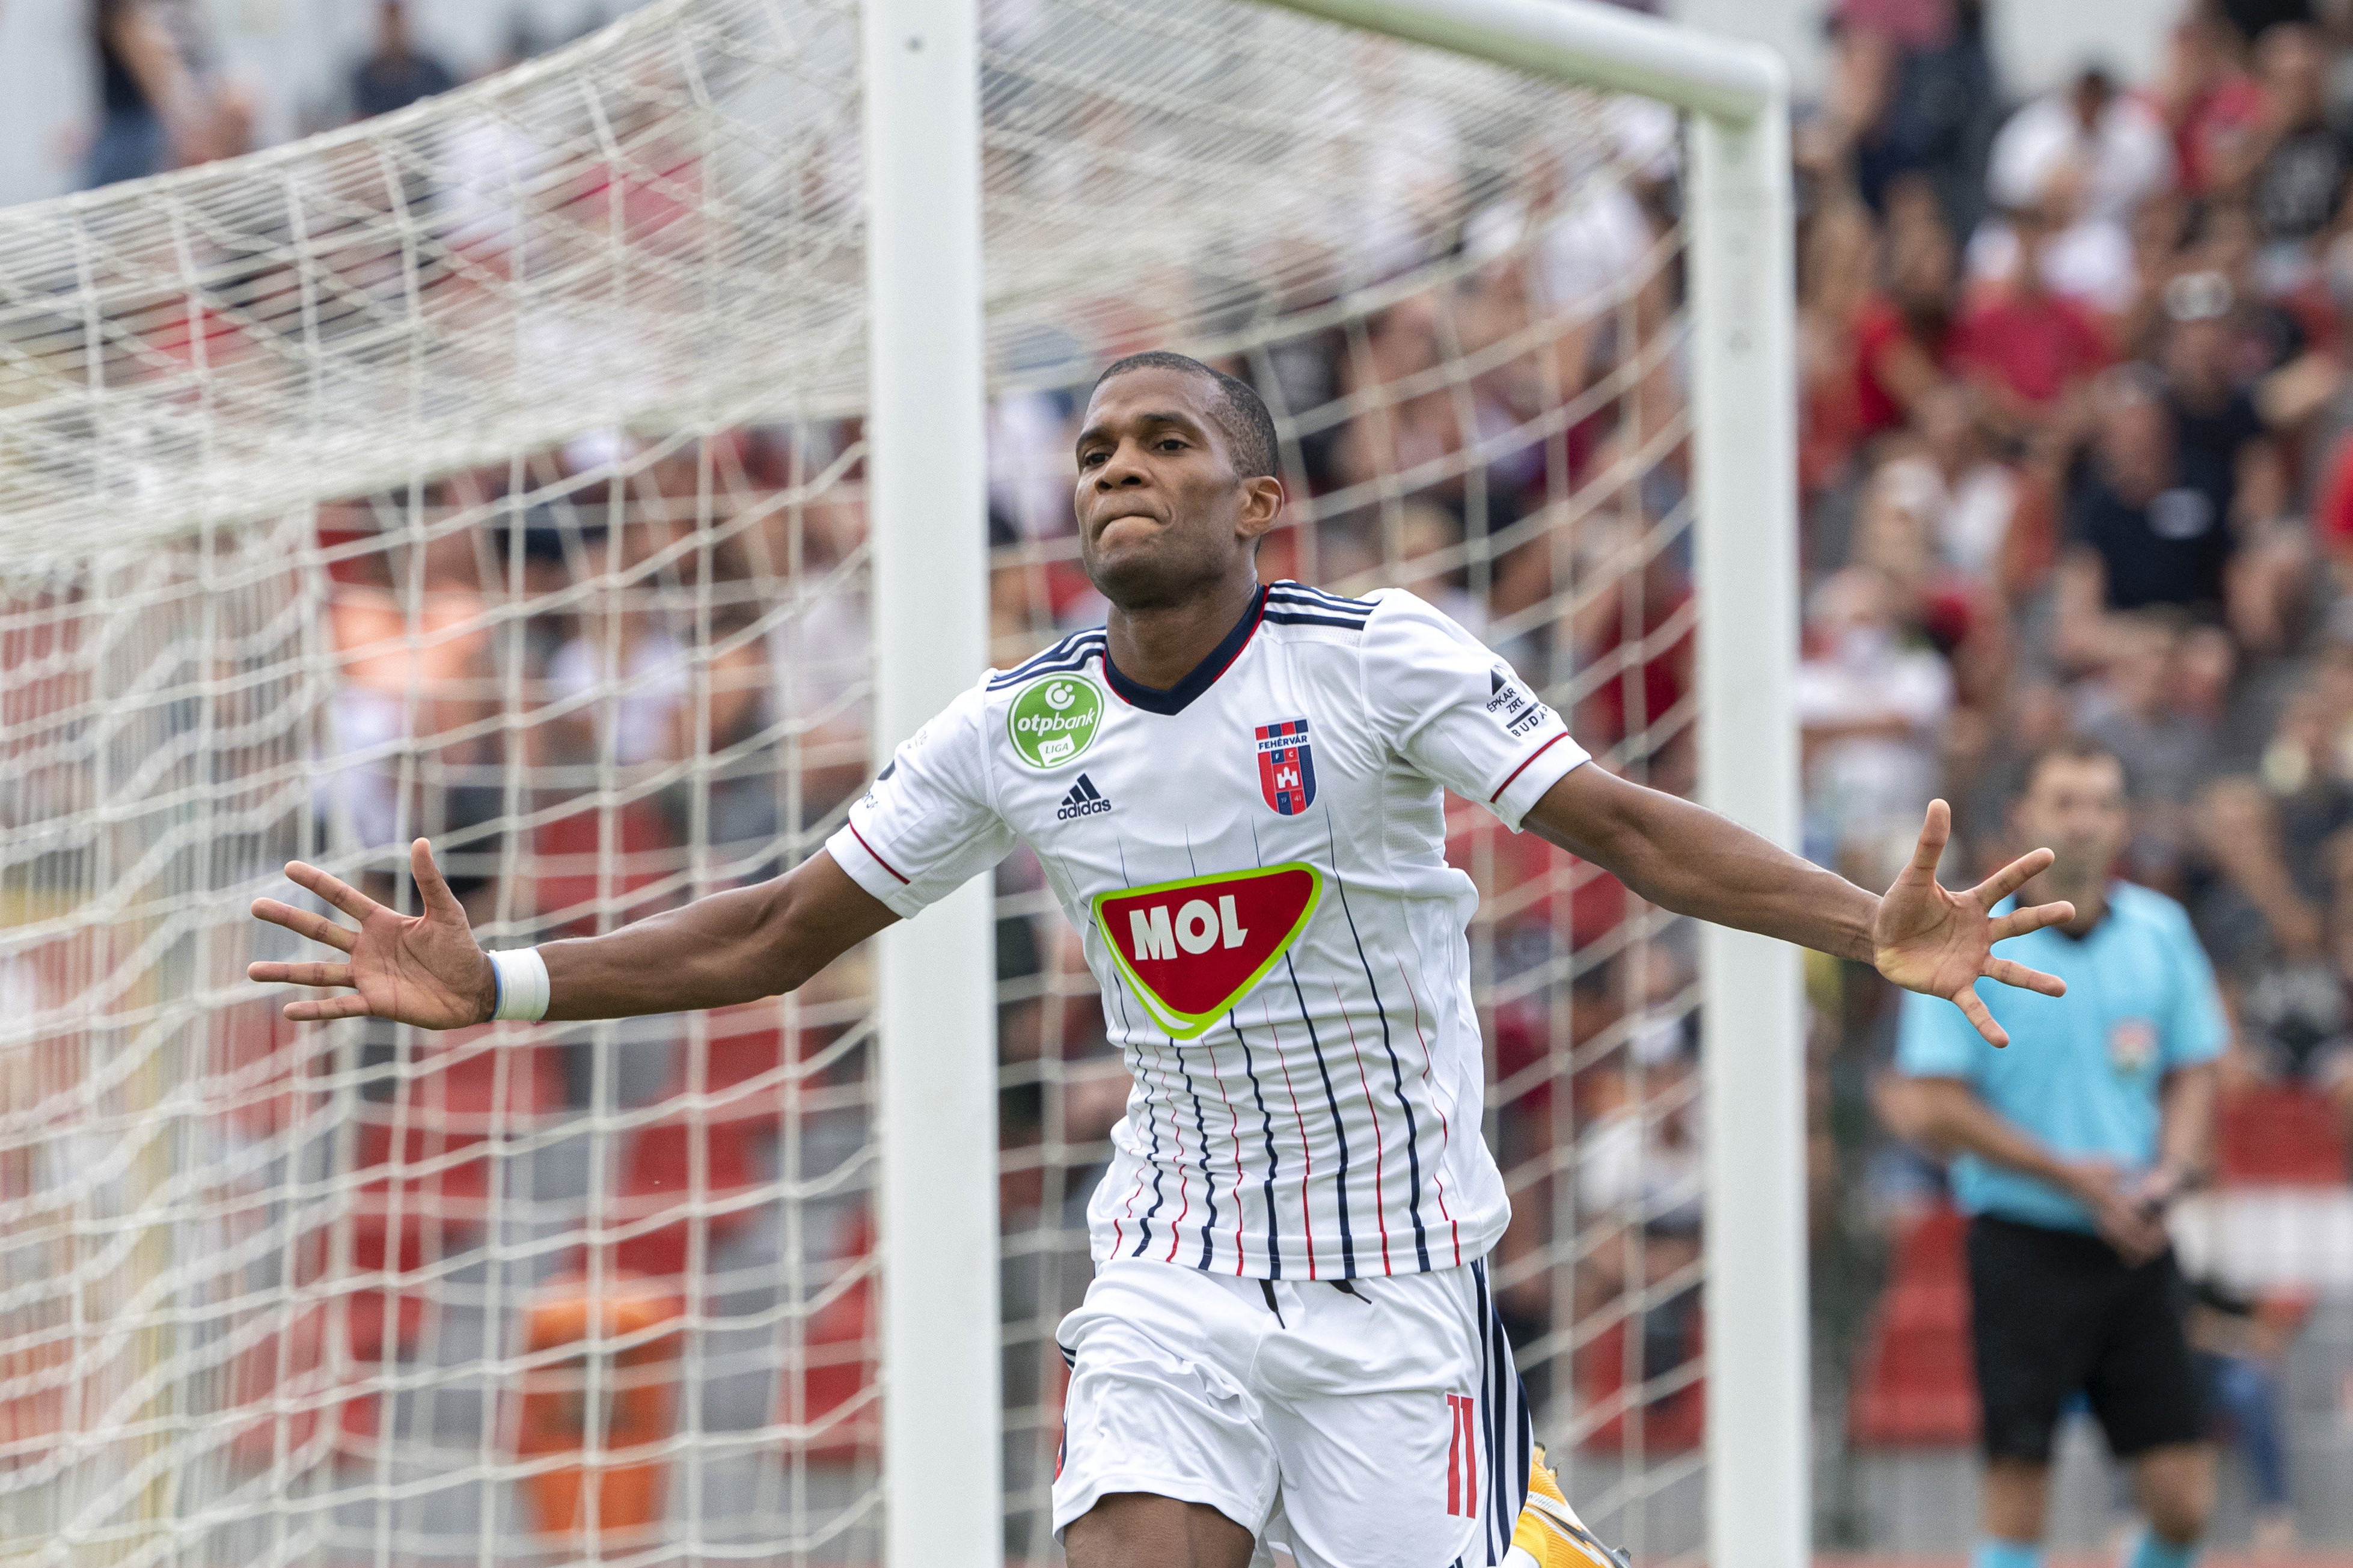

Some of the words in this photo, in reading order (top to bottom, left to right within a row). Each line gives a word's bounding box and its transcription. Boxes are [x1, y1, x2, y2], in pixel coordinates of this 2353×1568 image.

[1486, 688, 1516, 713] ÉPKAR
[1506, 697, 1525, 714] ZRT.
[1018, 707, 1096, 737] otpbank
[1045, 742, 1069, 754] LIGA
[1258, 734, 1308, 750] FEHÉRVÁR
[1057, 799, 1112, 820] adidas
[1128, 894, 1249, 961] MOL
[1446, 1394, 1477, 1519] 11
